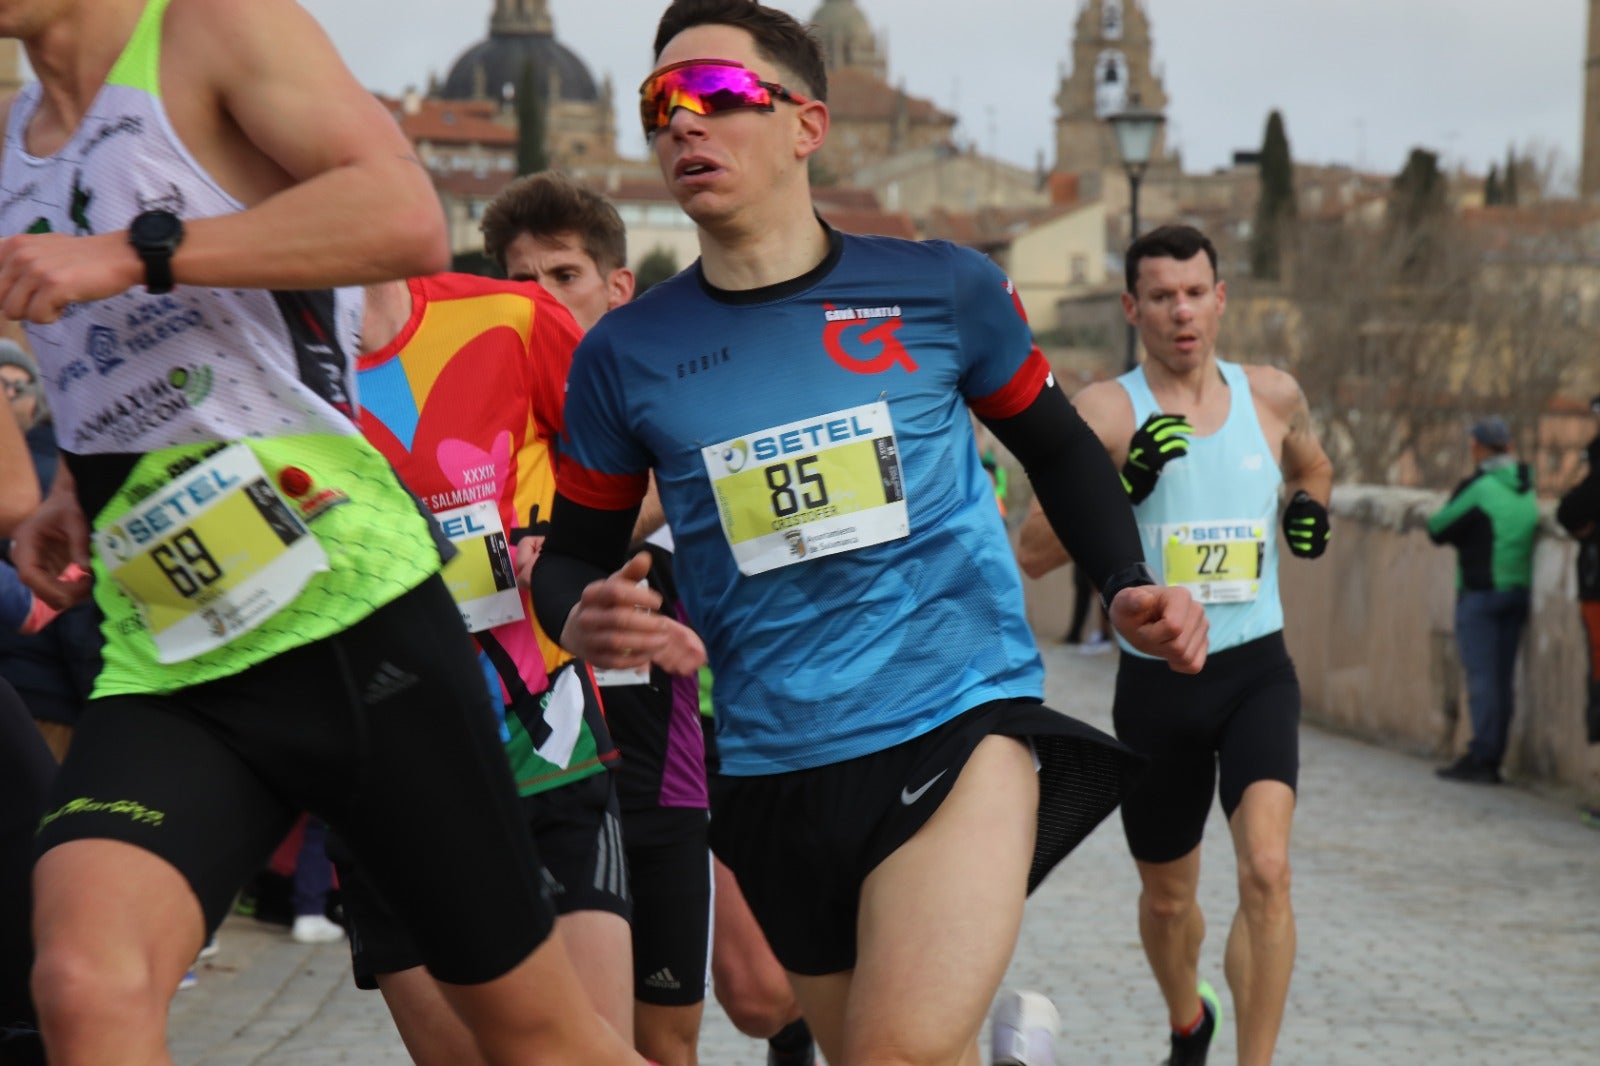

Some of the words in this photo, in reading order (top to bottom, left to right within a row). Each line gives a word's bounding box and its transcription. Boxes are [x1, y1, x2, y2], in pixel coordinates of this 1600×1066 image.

[676, 346, 731, 379] GOBIK
[753, 416, 872, 461] SETEL
[462, 464, 496, 485] XXXIX
[764, 454, 829, 517] 85
[125, 469, 241, 545] SETEL
[431, 481, 497, 510] SALMANTINA
[1192, 526, 1257, 541] SETEL
[150, 527, 224, 599] 69
[1196, 544, 1229, 575] 22
